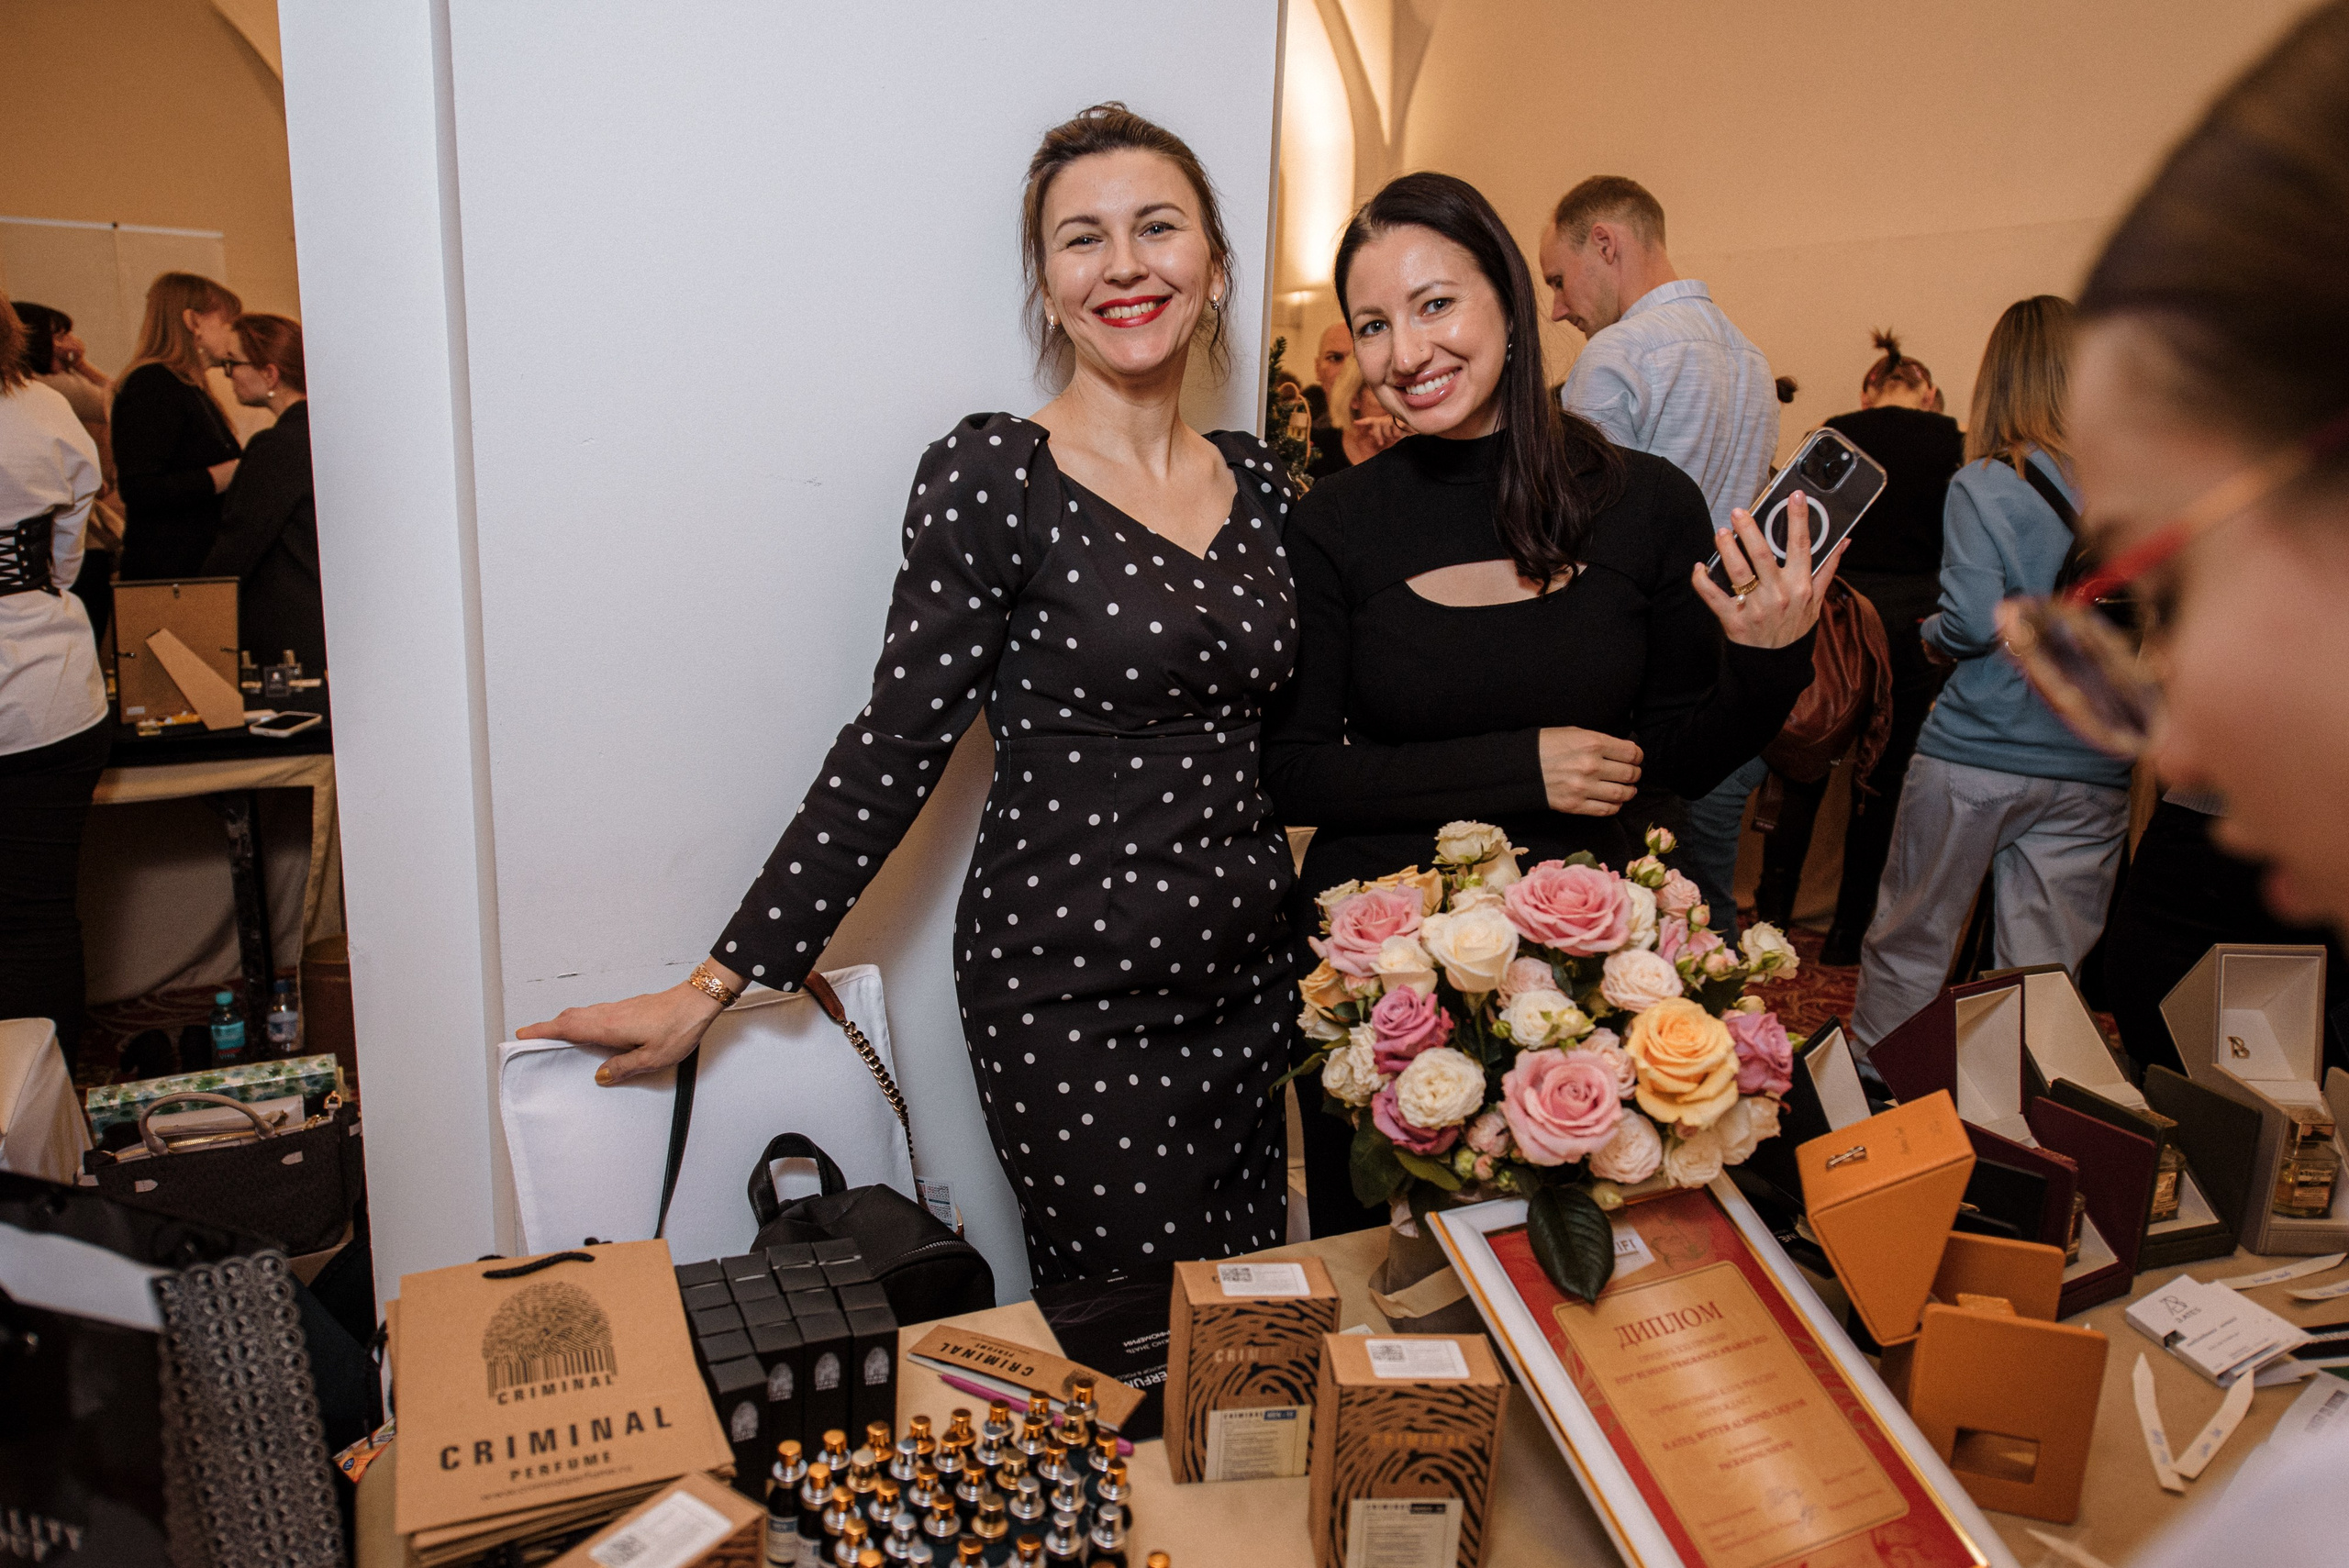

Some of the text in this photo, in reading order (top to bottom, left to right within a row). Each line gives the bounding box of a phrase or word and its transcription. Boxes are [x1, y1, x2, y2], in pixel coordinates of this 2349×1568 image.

[1613, 1300, 1724, 1351] ДИПЛОМ
[940, 1341, 1034, 1376] CRIMINAL
[497, 1374, 614, 1406] CRIMINAL
[440, 1406, 672, 1471] CRIMINAL
[510, 1451, 609, 1482] PERFUME
